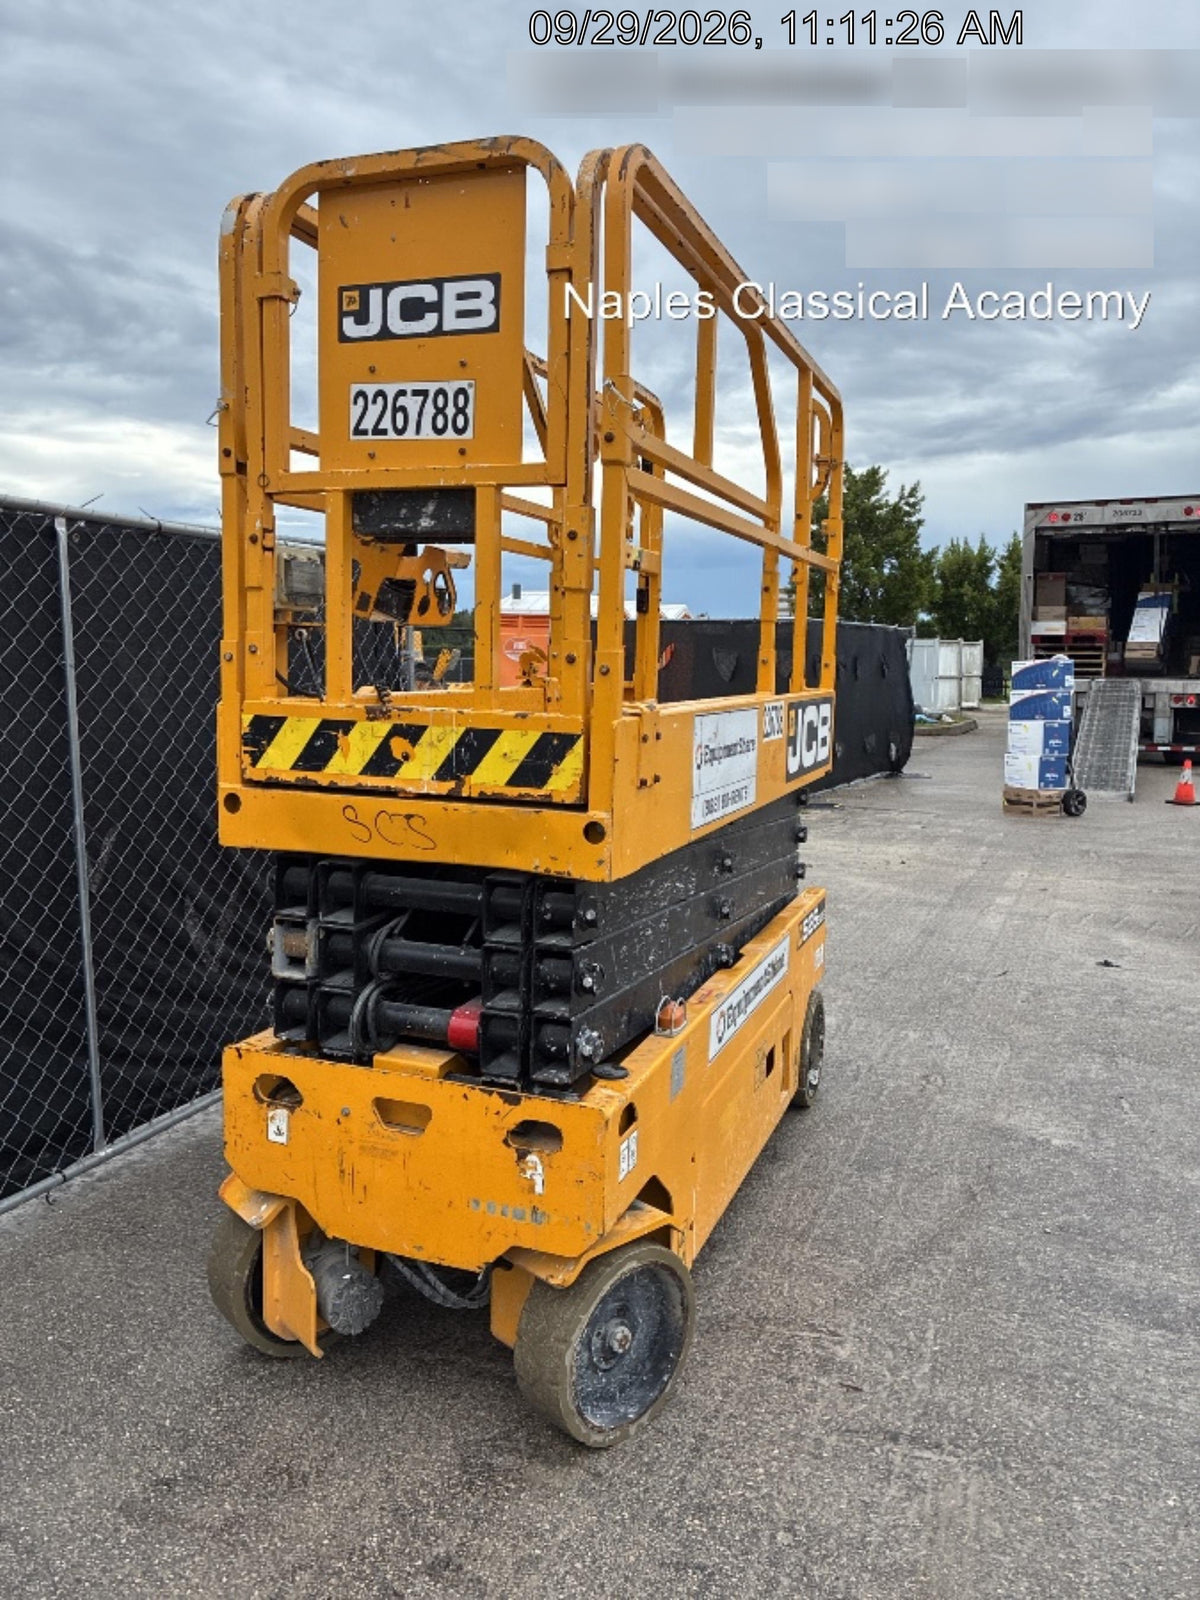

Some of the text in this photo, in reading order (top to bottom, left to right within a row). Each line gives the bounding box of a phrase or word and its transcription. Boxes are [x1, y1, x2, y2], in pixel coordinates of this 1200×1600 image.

[342, 279, 497, 339] JCB
[351, 387, 471, 438] 226788
[788, 703, 832, 774] JCB
